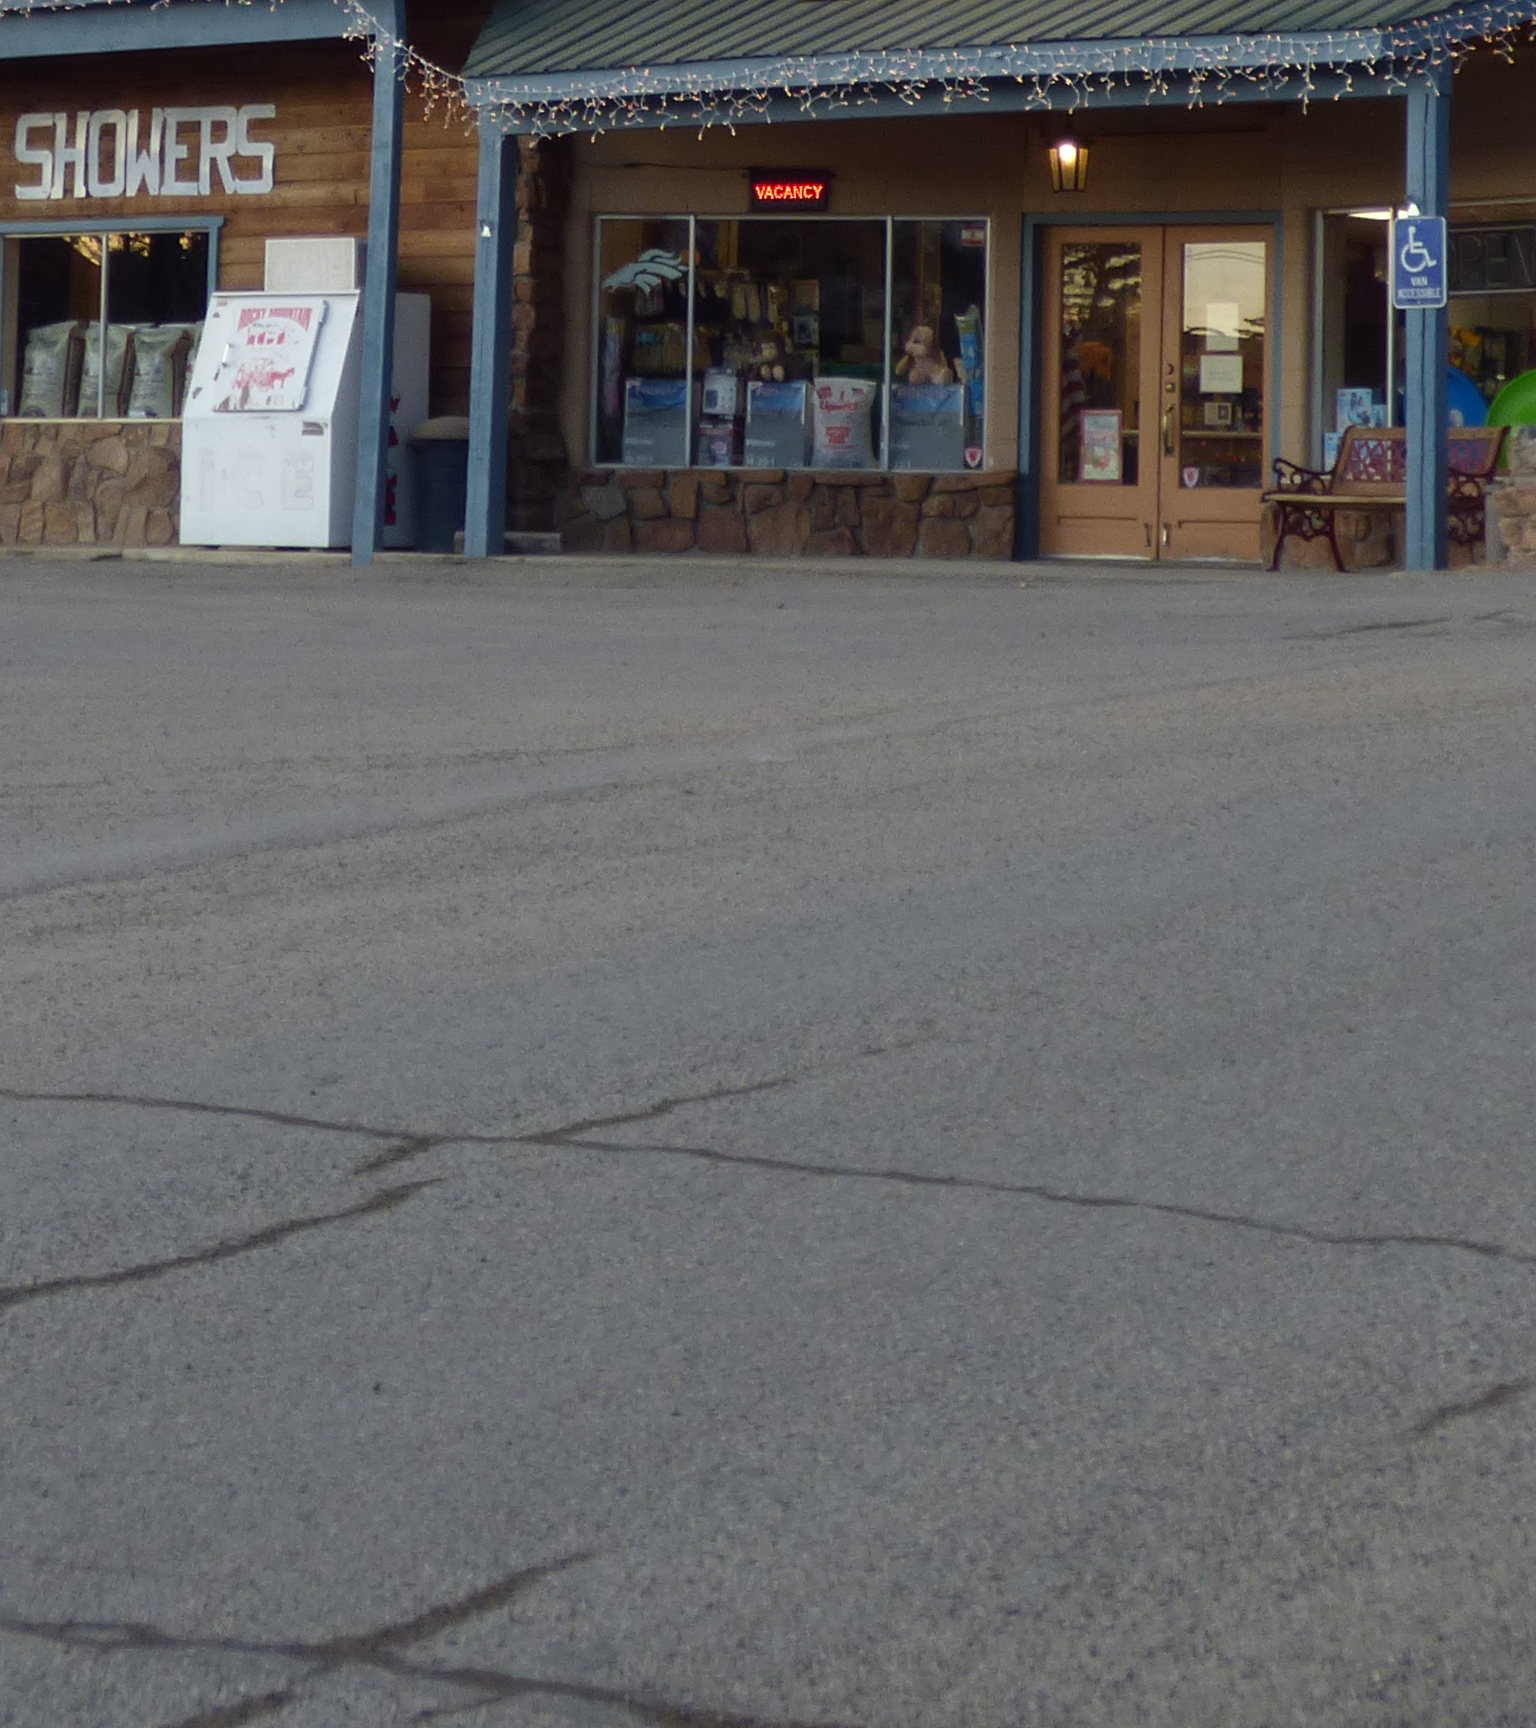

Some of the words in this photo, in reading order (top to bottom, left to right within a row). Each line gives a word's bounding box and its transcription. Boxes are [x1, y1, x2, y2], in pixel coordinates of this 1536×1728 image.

[15, 104, 276, 200] SHOWERS
[755, 184, 824, 200] VACANCY
[1411, 276, 1428, 286] VAN
